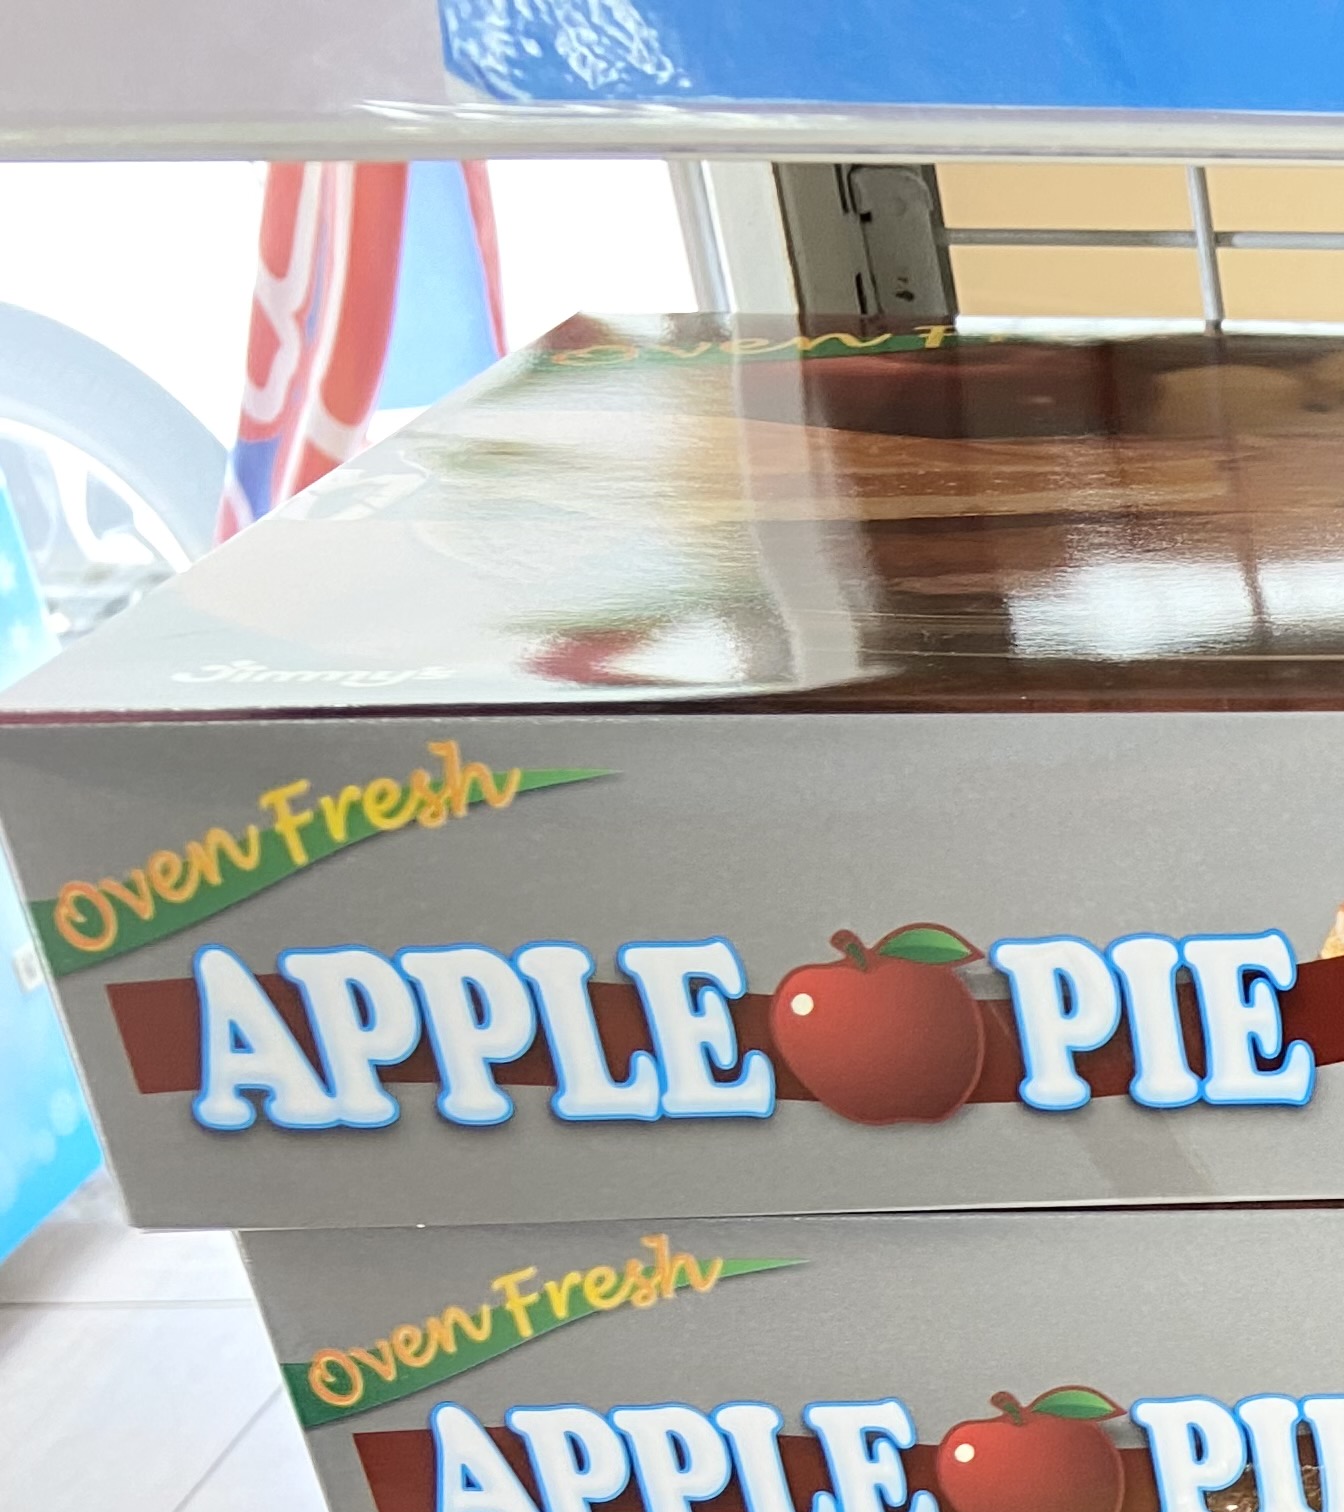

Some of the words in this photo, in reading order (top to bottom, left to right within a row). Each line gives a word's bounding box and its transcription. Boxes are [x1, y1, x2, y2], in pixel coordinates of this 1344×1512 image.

[171, 660, 455, 687] Jimmy's
[53, 820, 261, 952] Oven
[259, 740, 521, 866] Fresh
[192, 936, 777, 1132] APPLE
[988, 928, 1317, 1112] PIE
[309, 1300, 493, 1407] Oven
[492, 1233, 724, 1339] Fresh
